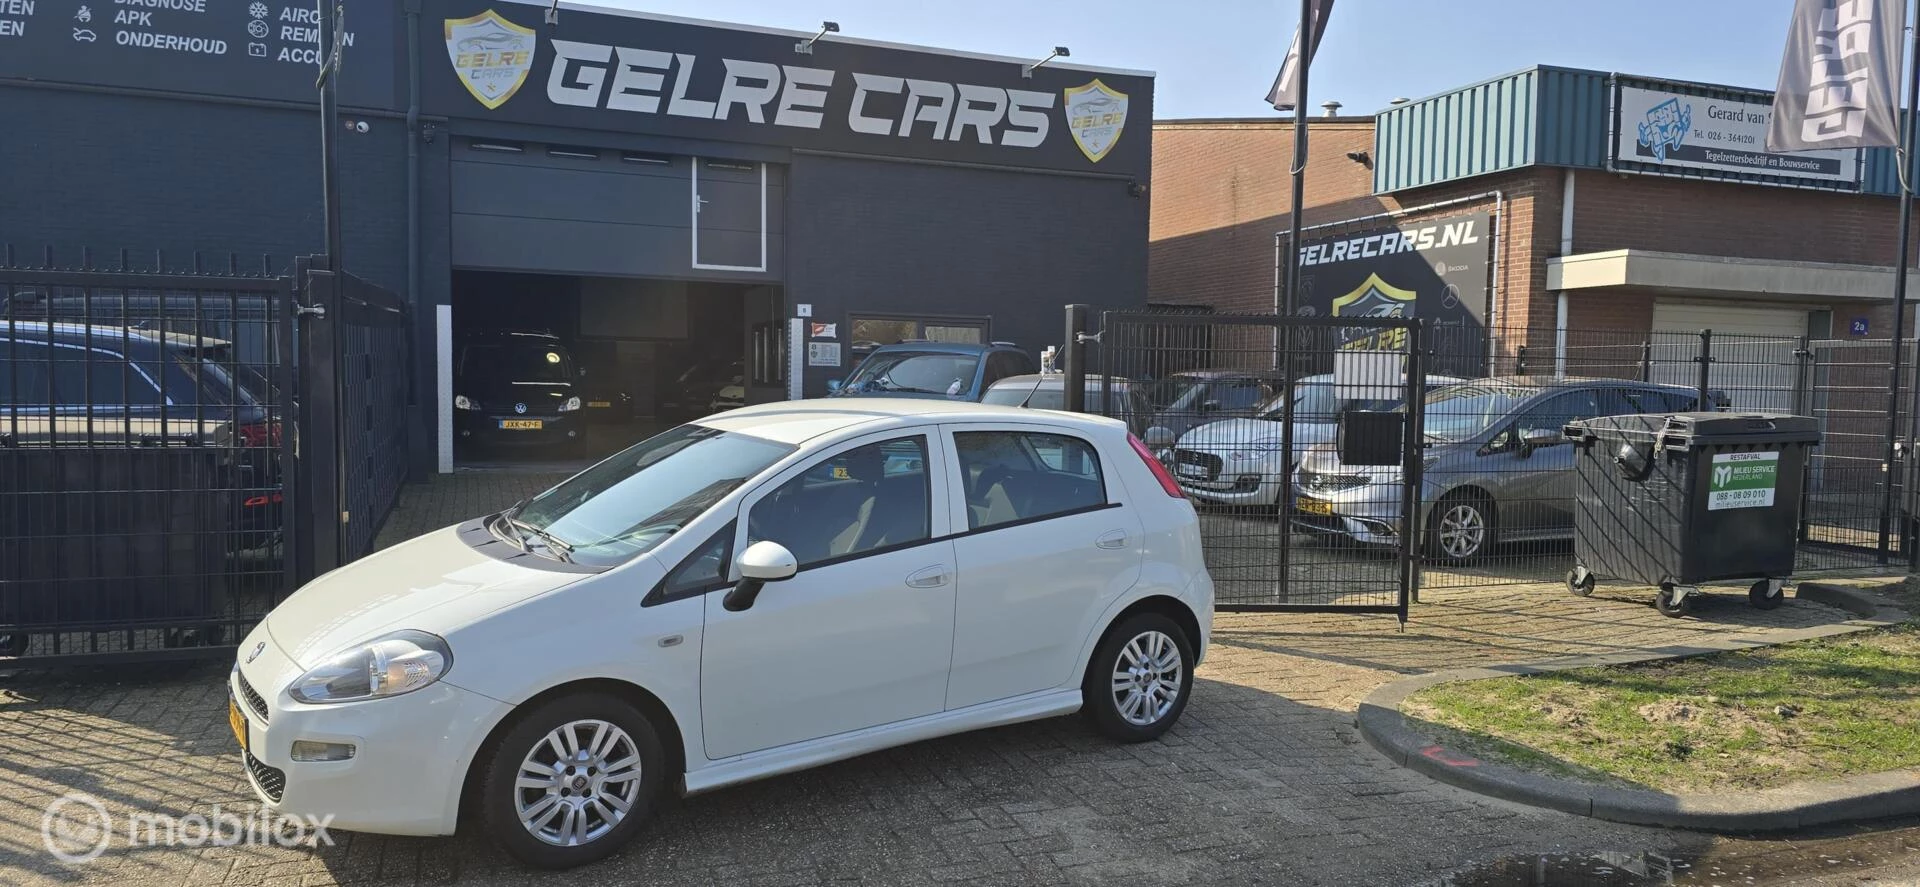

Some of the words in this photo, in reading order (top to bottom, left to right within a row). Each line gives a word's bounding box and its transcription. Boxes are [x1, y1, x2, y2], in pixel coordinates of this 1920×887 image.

[114, 0, 206, 12] GNOSE
[114, 9, 152, 27] APK
[116, 30, 227, 54] ONDERHOUD
[280, 25, 354, 47] REMN
[455, 51, 529, 68] GELRE
[547, 39, 835, 129] GELRE
[848, 72, 1056, 148] CARS
[1708, 105, 1744, 122] Gerard
[1746, 114, 1764, 124] van
[1707, 131, 1720, 141] 026
[1728, 133, 1755, 144] 3641201
[1705, 150, 1767, 167] Tegelzettersbedrijf
[1779, 157, 1820, 171] Bouwservice
[1854, 321, 1865, 331] 2a
[1733, 466, 1752, 474] MILIEU
[1752, 465, 1776, 473] SERVICE
[1717, 492, 1728, 501] 088
[1733, 491, 1741, 499] 08
[1743, 490, 1751, 498] 09
[1753, 489, 1766, 498] 010
